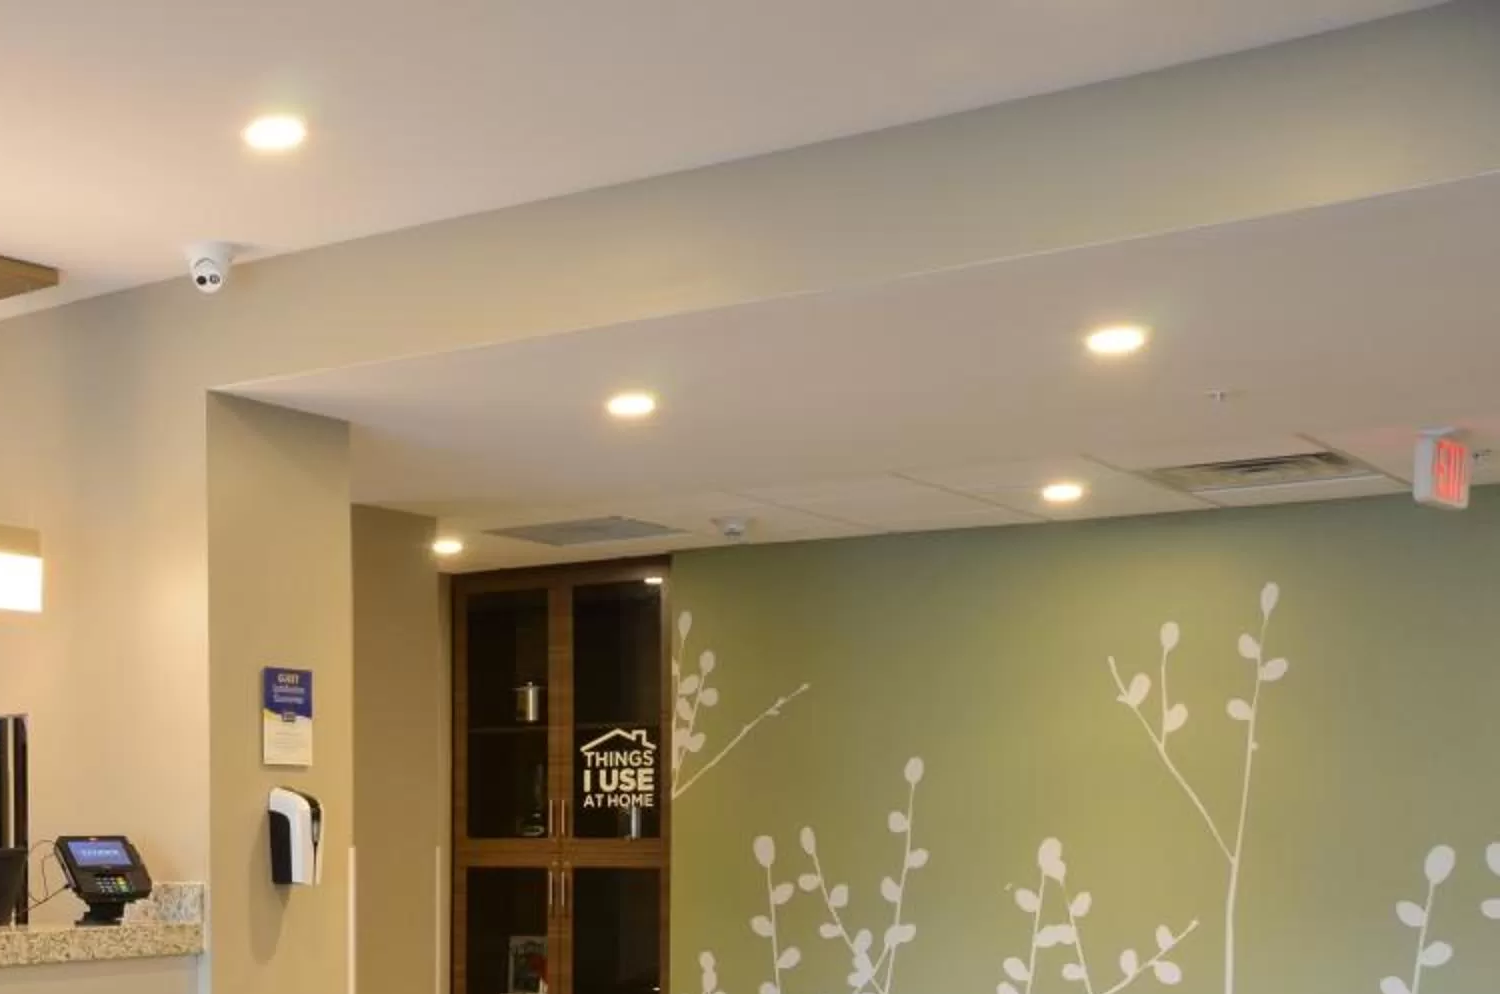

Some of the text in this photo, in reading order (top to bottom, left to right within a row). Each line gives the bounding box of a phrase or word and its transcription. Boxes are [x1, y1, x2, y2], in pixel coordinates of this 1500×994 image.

[584, 750, 654, 767] THINGS
[583, 768, 654, 792] I USE
[583, 793, 654, 808] AT HOME
